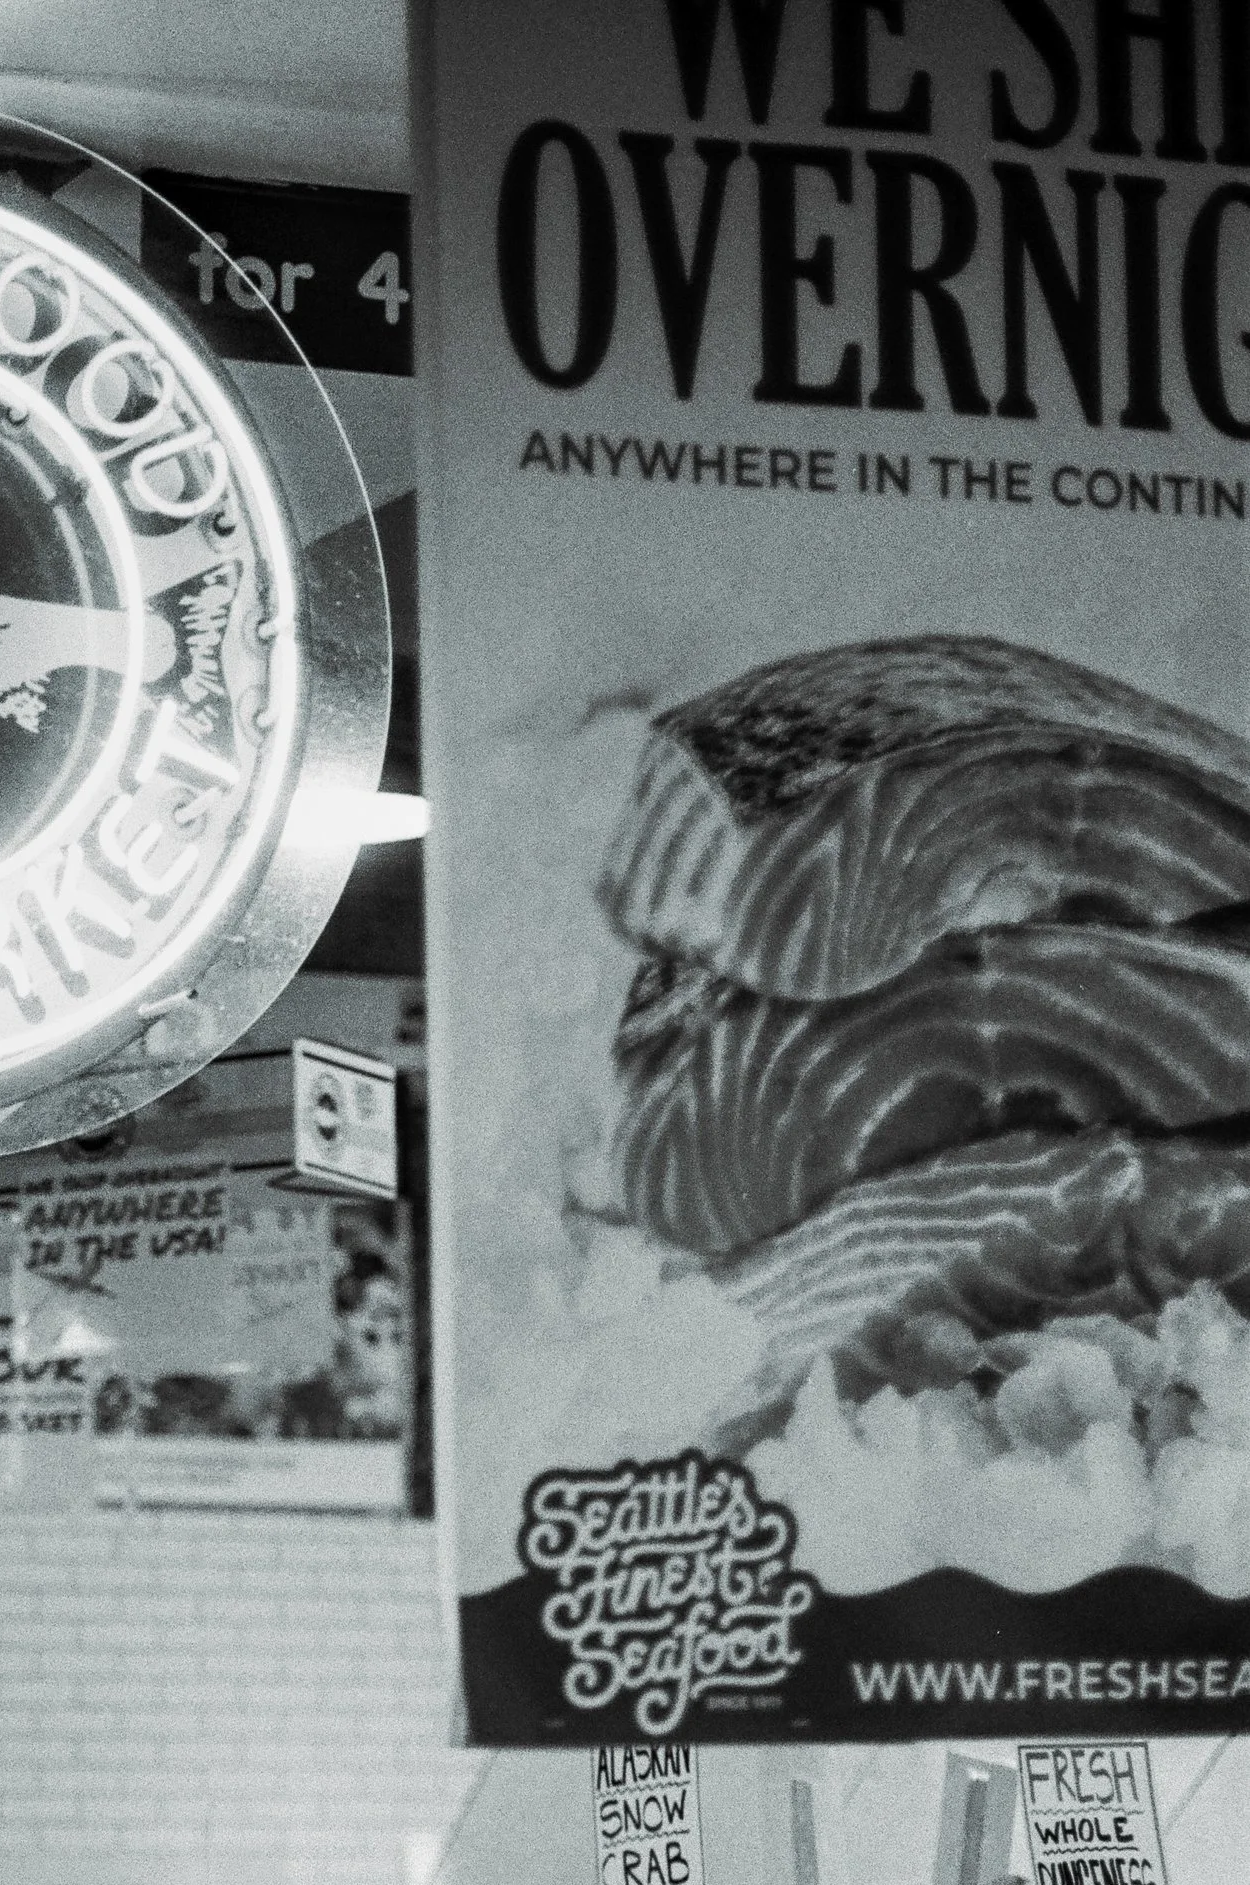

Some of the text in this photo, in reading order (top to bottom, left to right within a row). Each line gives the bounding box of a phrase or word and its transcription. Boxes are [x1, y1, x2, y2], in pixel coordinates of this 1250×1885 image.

[187, 231, 411, 326] for 4
[518, 430, 1248, 519] ANYWHERE IN THE CONTIN
[26, 1186, 226, 1231] ANYWHERE
[26, 1223, 227, 1270] IN THE USA!
[526, 1460, 758, 1570] Seattle's
[540, 1520, 788, 1640] Finest
[561, 1583, 813, 1736] Seafood
[596, 1744, 691, 1790] ALASKAN
[1025, 1750, 1141, 1805] FRESH
[600, 1789, 688, 1840] SNOW
[1034, 1816, 1135, 1846] WHOLE
